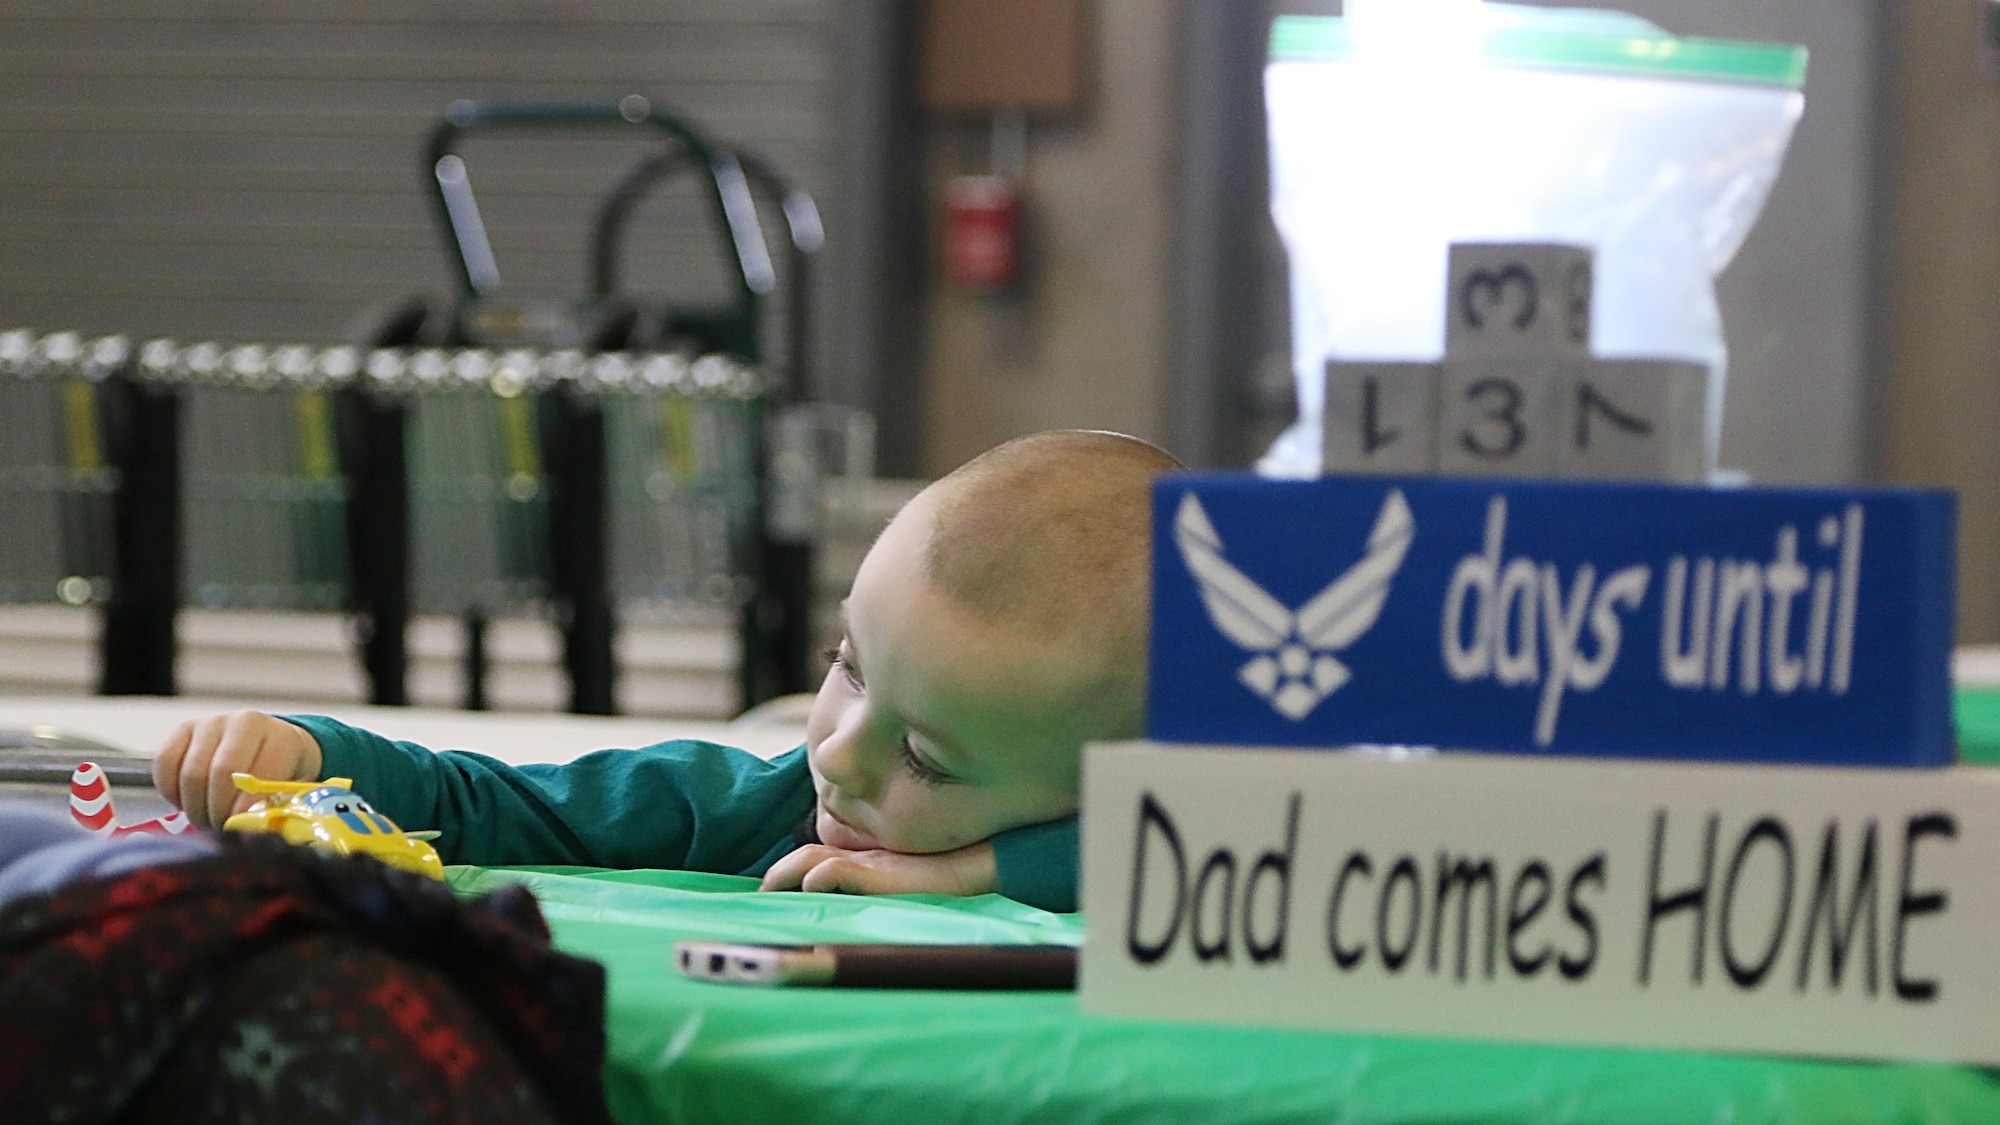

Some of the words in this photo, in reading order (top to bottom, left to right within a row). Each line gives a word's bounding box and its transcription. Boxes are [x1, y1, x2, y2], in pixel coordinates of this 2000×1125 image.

[1458, 376, 1528, 459] 3
[1441, 496, 1651, 746] days
[1660, 502, 1864, 696] until
[1128, 792, 1301, 966] Dad
[1328, 849, 1606, 982] comes
[1636, 808, 1958, 1001] HOME
